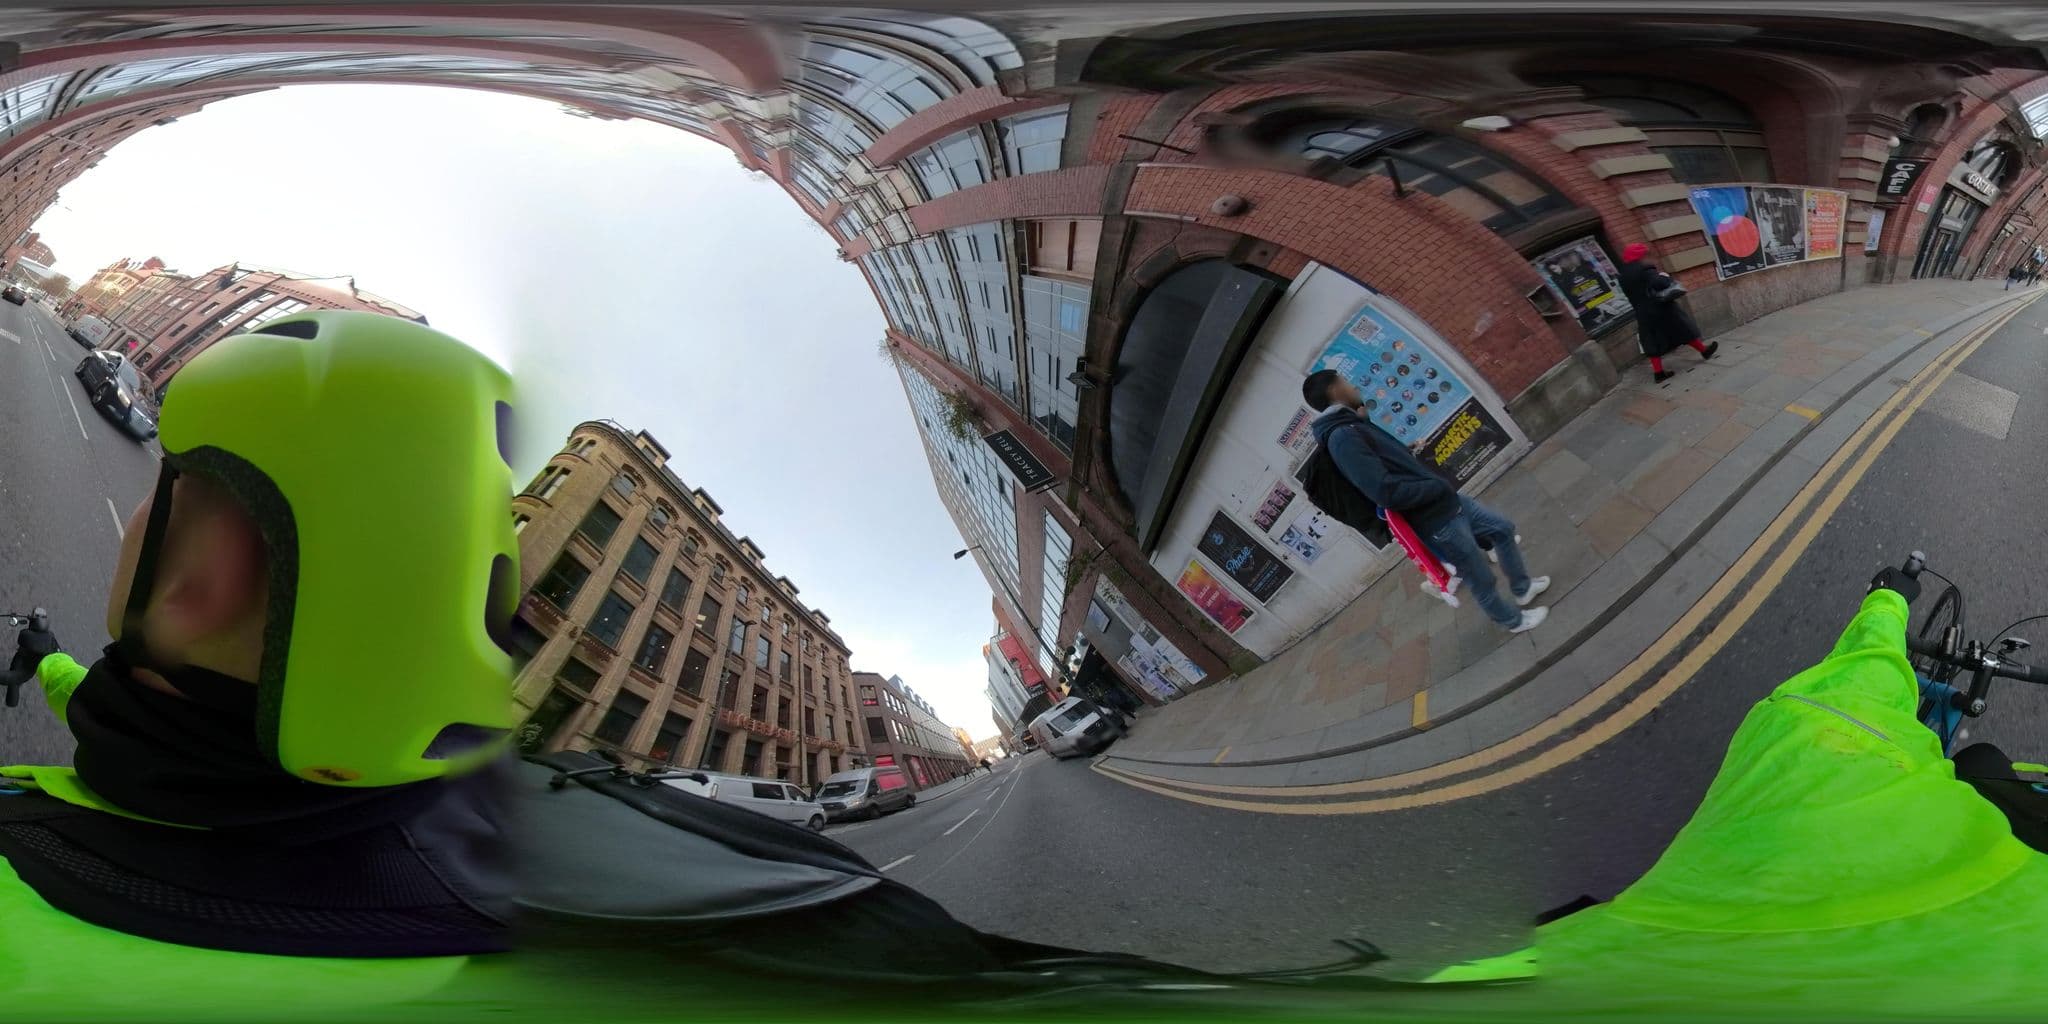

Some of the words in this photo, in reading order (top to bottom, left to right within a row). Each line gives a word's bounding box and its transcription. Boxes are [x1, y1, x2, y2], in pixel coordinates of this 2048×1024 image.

[1887, 163, 1916, 193] CAFE
[995, 436, 1012, 452] BELL
[1434, 411, 1471, 456] ANTARCTIC
[1435, 416, 1481, 466] MONKEYS
[1010, 452, 1039, 480] TRACEY
